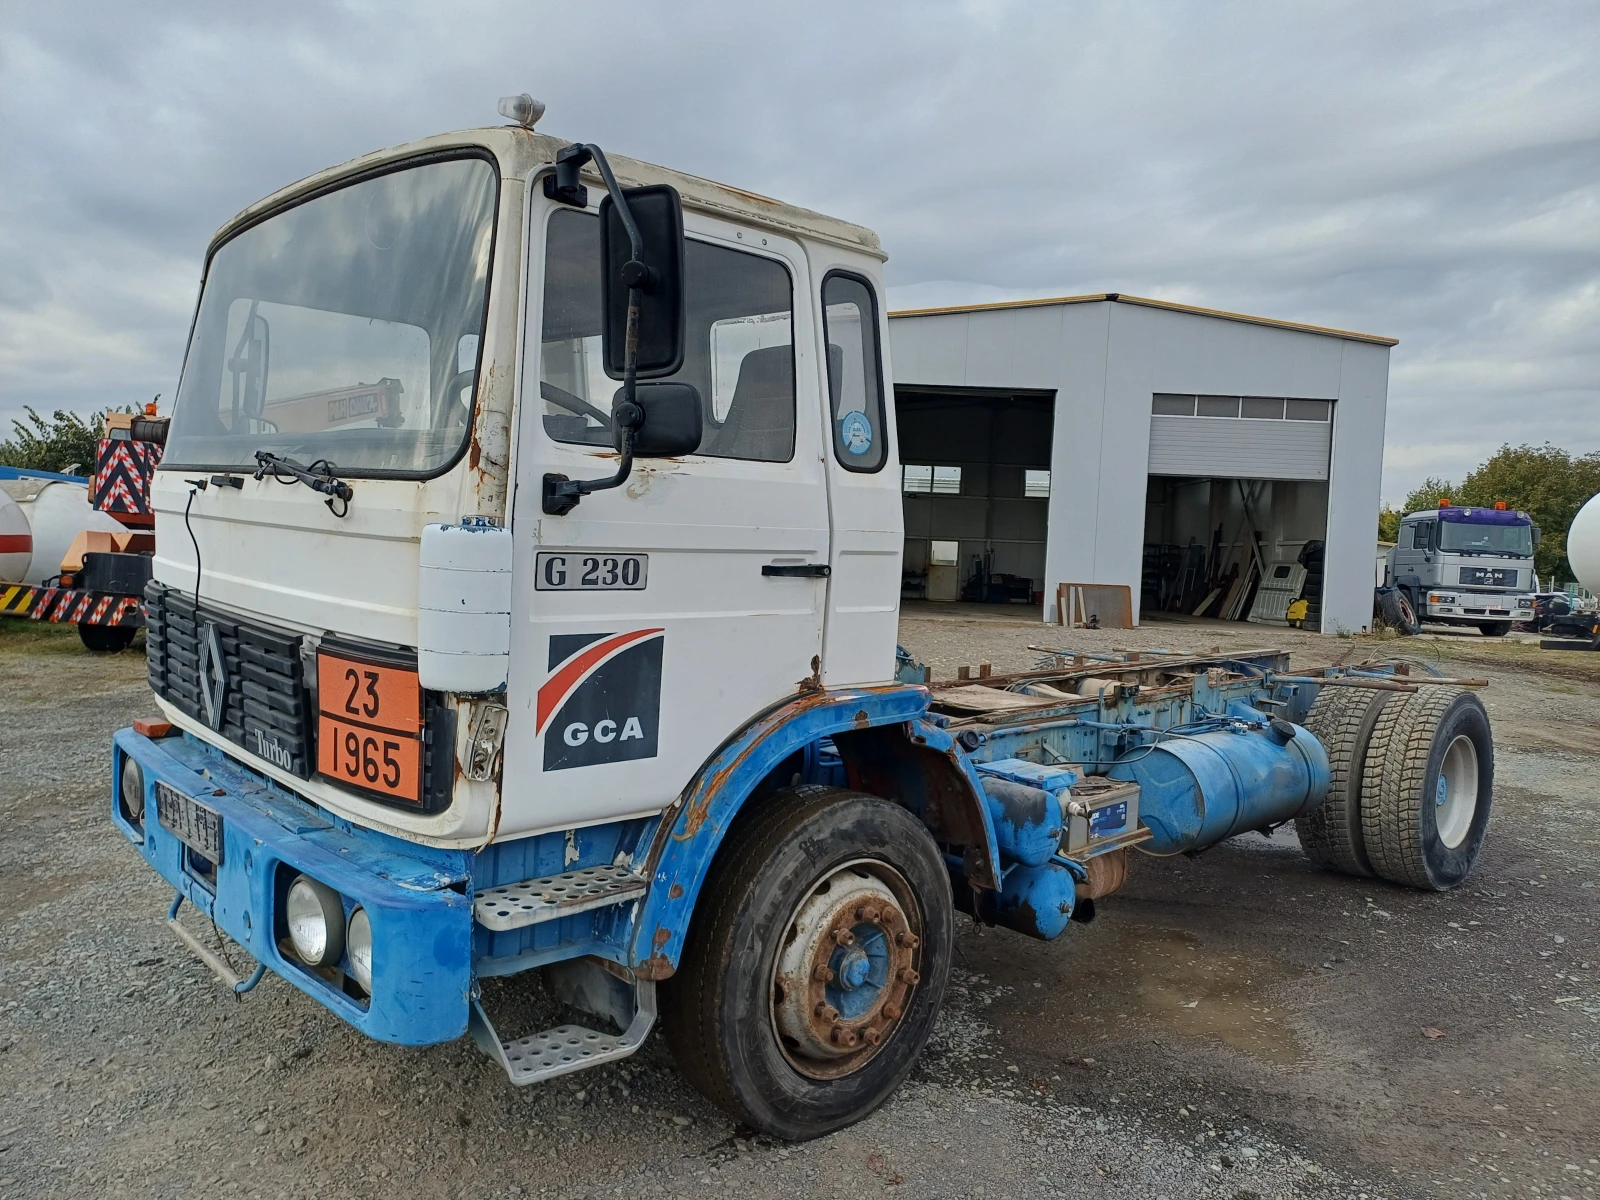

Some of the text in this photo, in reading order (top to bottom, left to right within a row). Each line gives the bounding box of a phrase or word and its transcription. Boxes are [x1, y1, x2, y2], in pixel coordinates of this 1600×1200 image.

[544, 556, 641, 586] G 230
[345, 668, 380, 718] 23
[254, 728, 292, 771] Turbo
[563, 716, 644, 747] GCA
[333, 726, 401, 788] 1965
